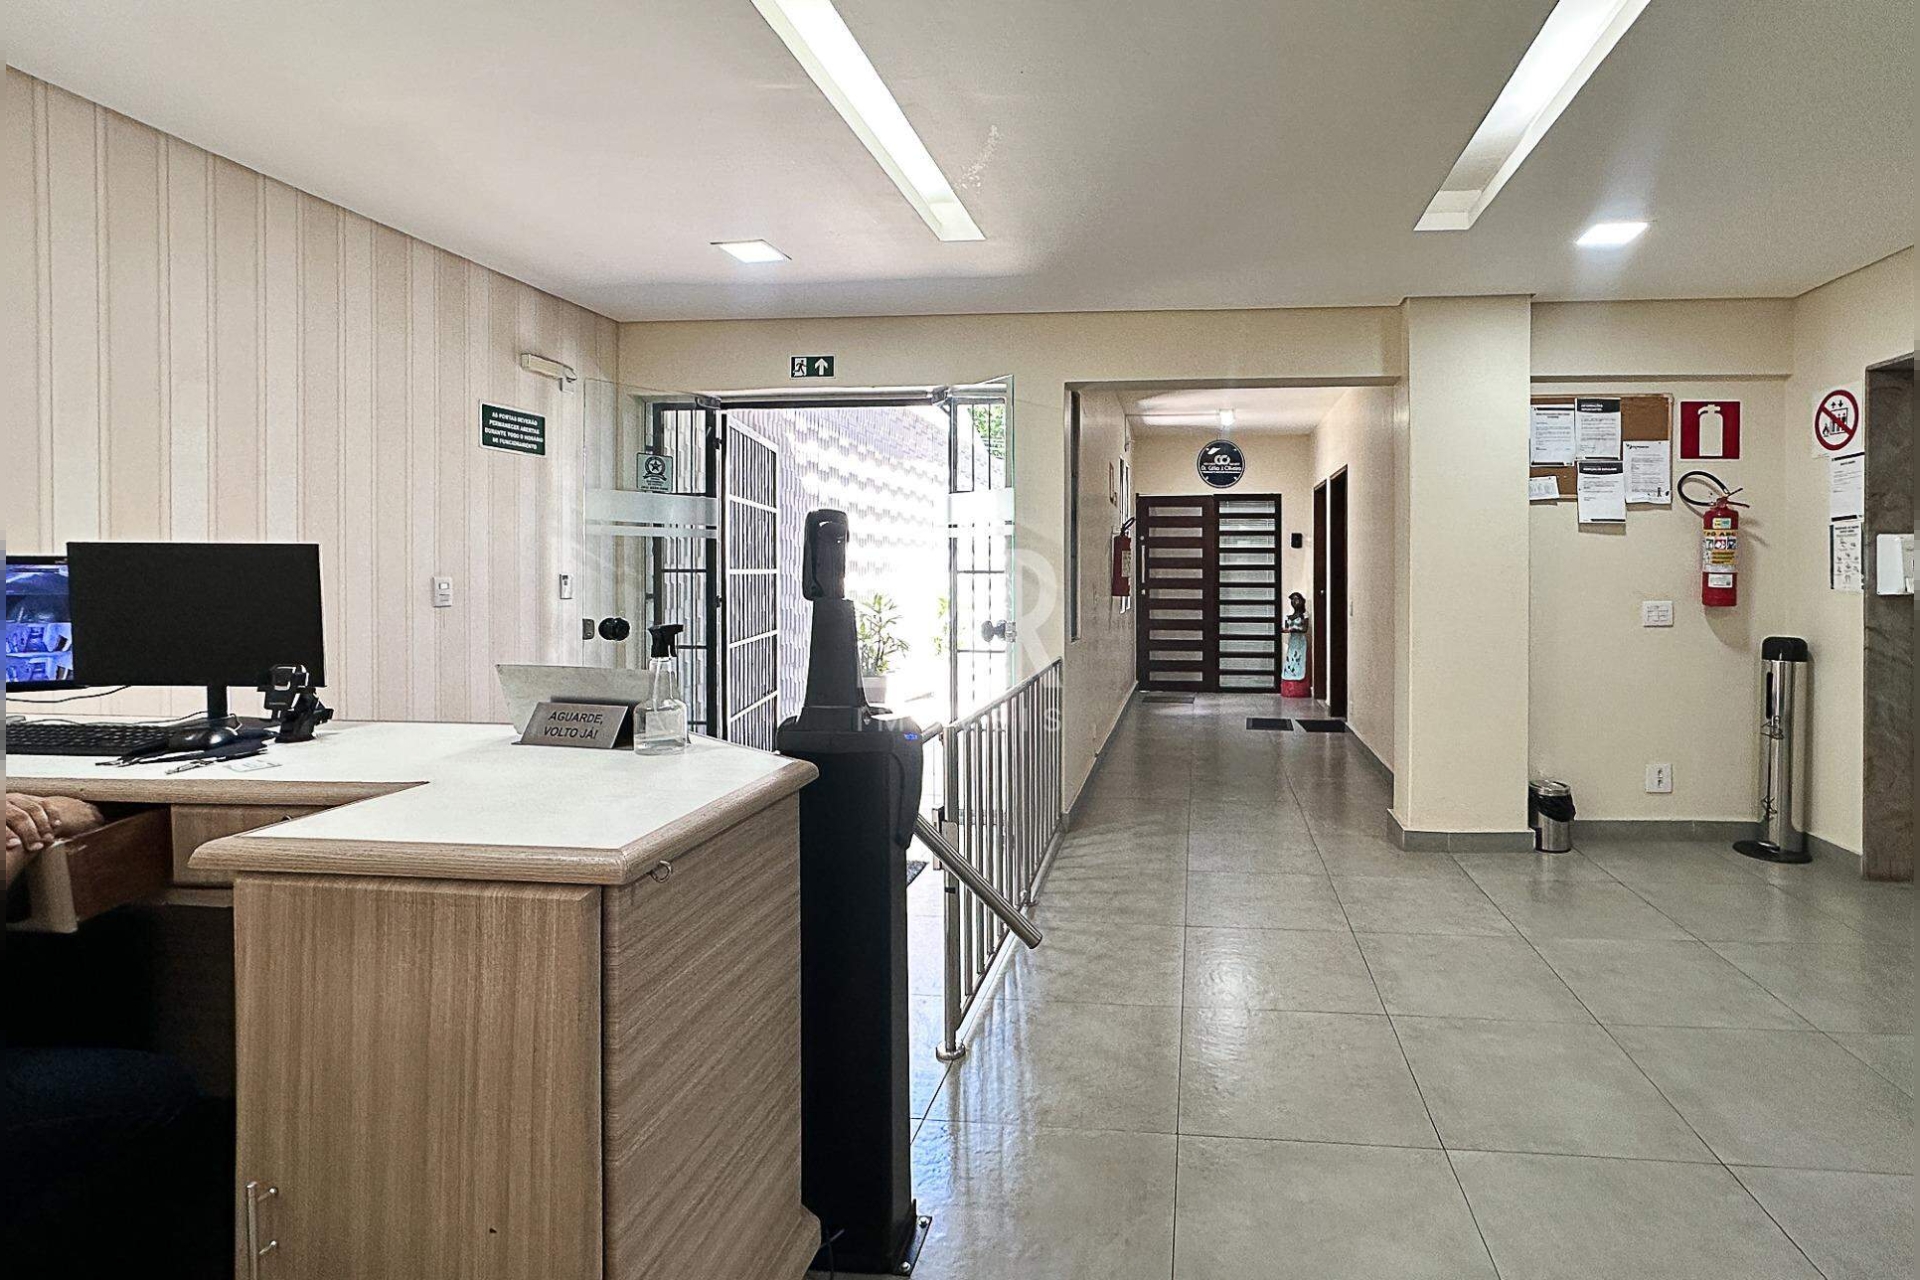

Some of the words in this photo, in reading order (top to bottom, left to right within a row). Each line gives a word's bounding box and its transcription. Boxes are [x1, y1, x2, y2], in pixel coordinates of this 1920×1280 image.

[499, 413, 517, 422] PORTAS
[517, 416, 538, 426] DEVERÃO
[484, 427, 506, 437] DURANTE
[489, 419, 520, 430] PERMANECER
[520, 426, 540, 434] ABERTAS
[499, 438, 537, 449] FUNCIONAMENTO
[548, 711, 604, 725] AGUARDE,
[544, 726, 578, 738] VOLTO
[579, 726, 599, 740] JÁ!
